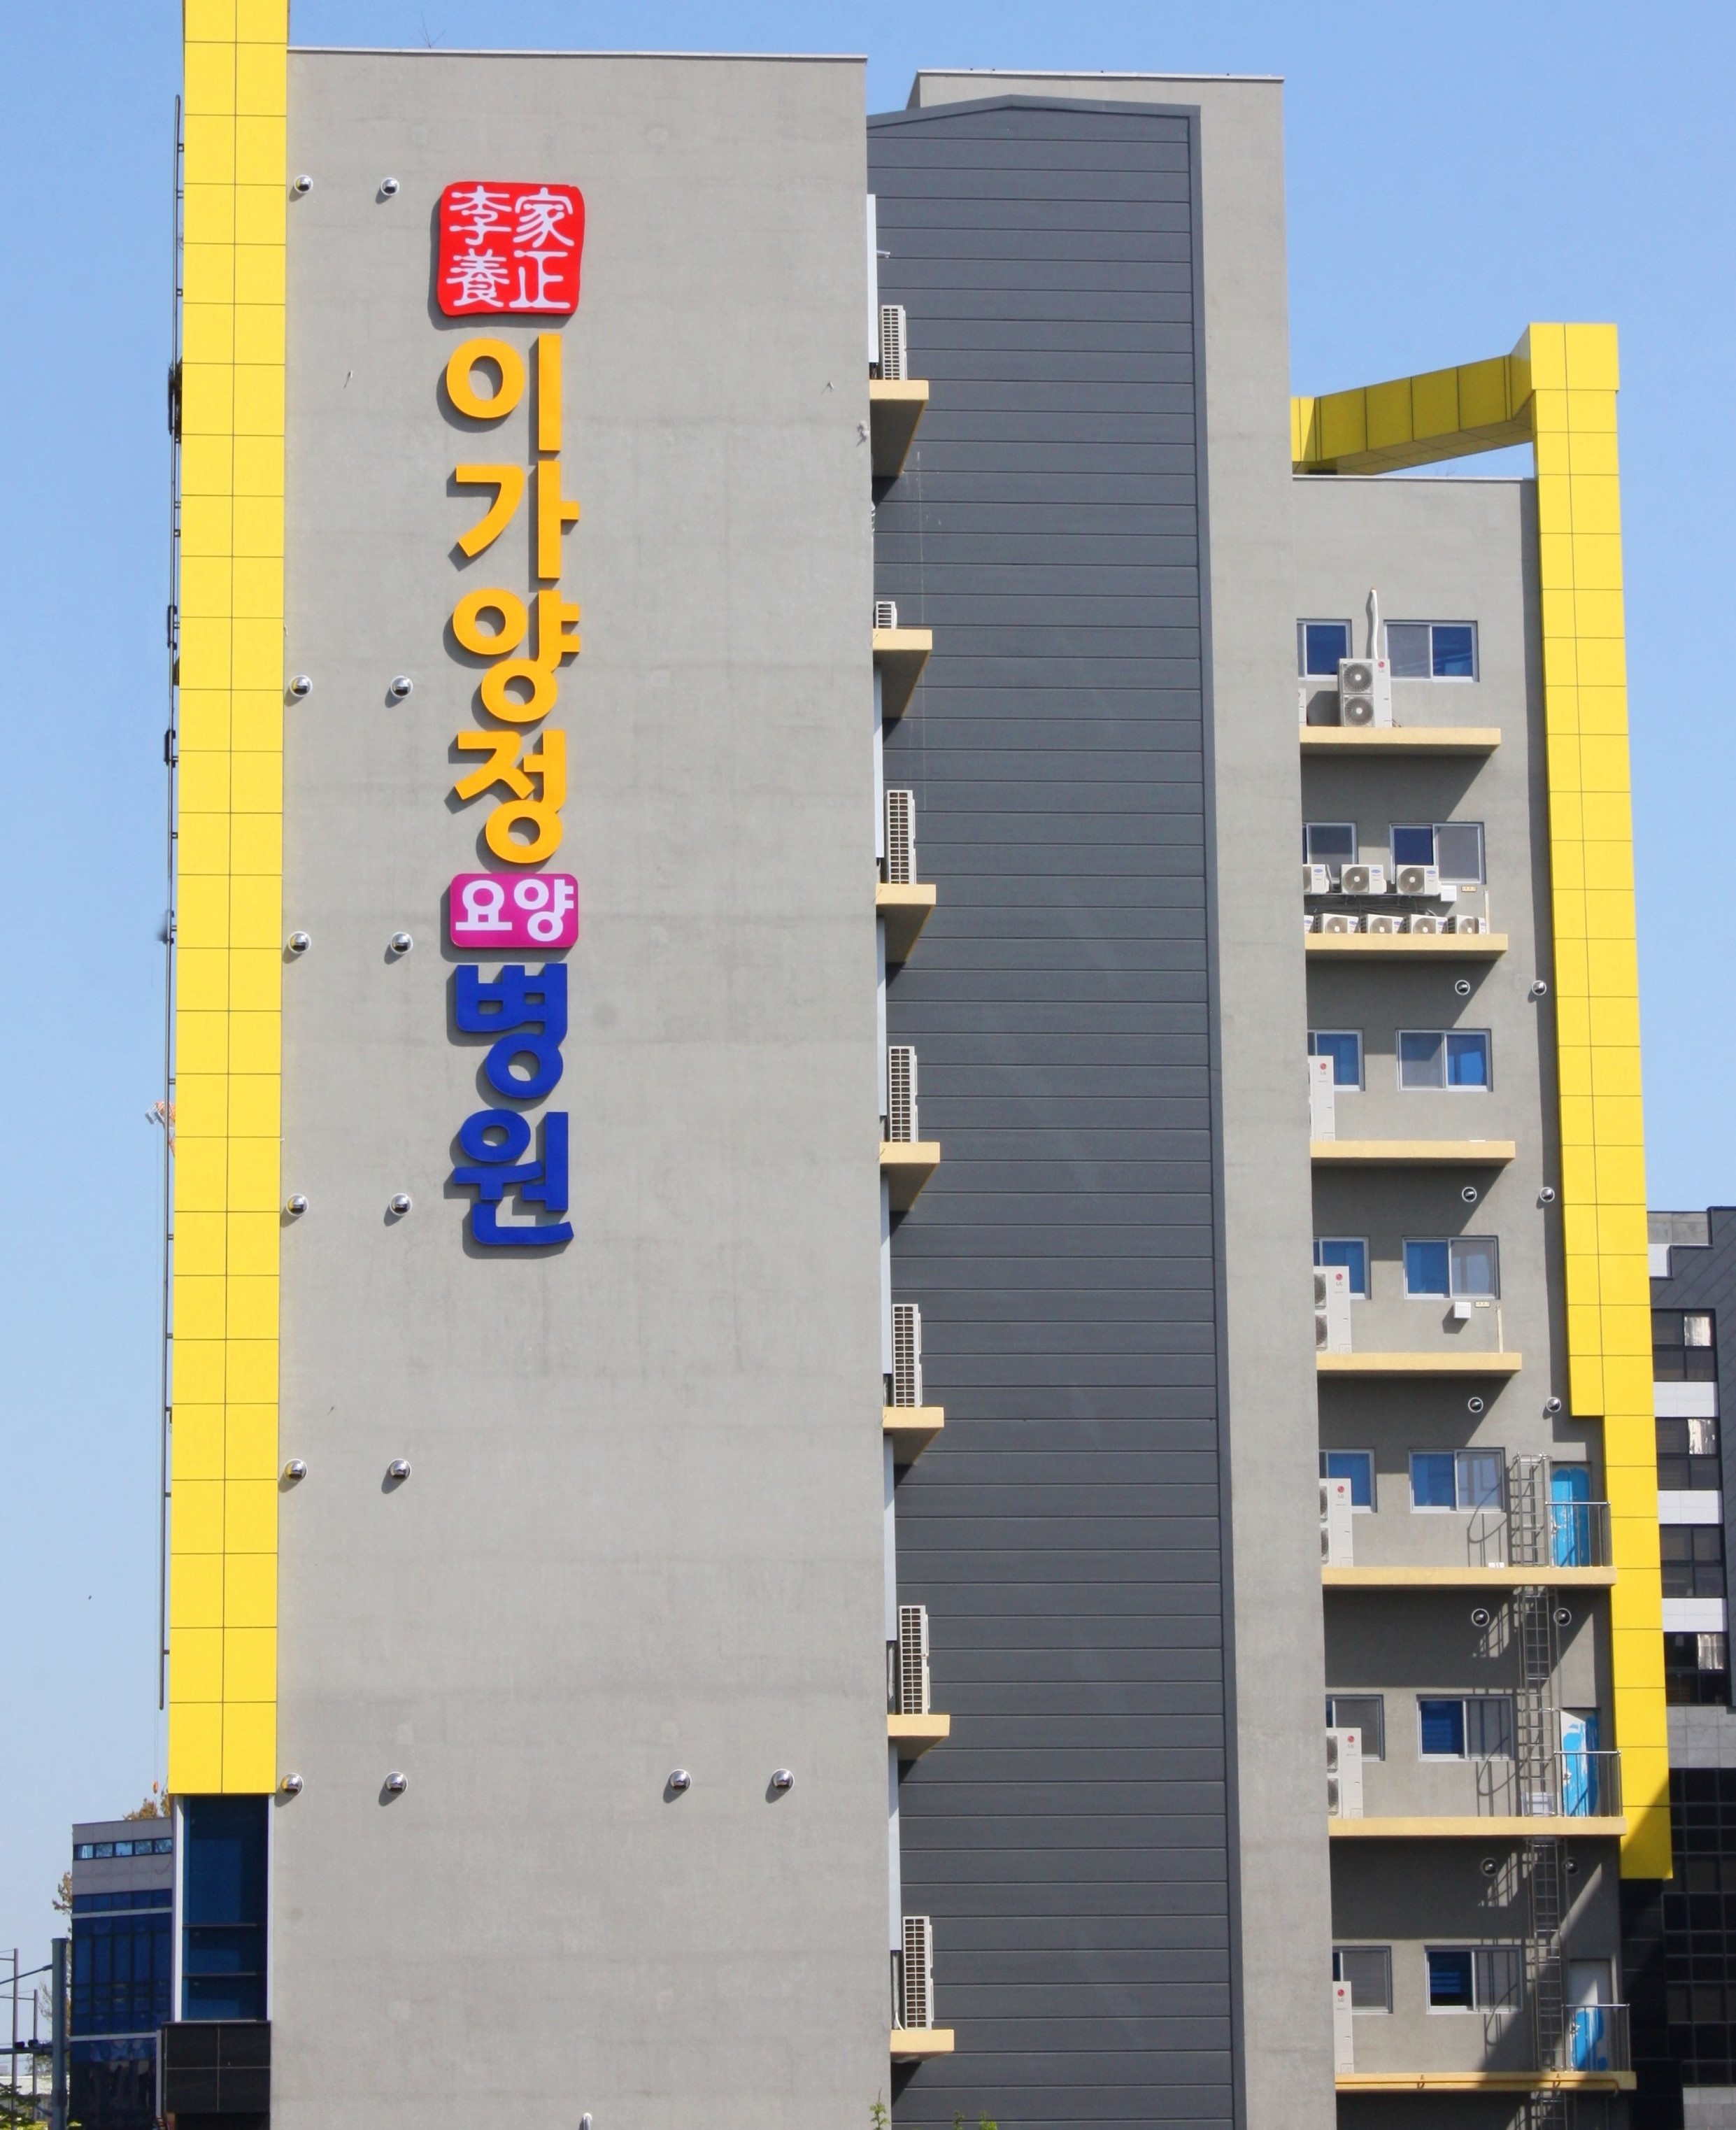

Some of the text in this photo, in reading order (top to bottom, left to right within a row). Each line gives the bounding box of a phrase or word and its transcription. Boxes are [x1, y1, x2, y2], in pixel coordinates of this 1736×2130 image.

[446, 334, 580, 863] 이가양정
[455, 879, 574, 942] 요양
[454, 964, 573, 1245] 병원
